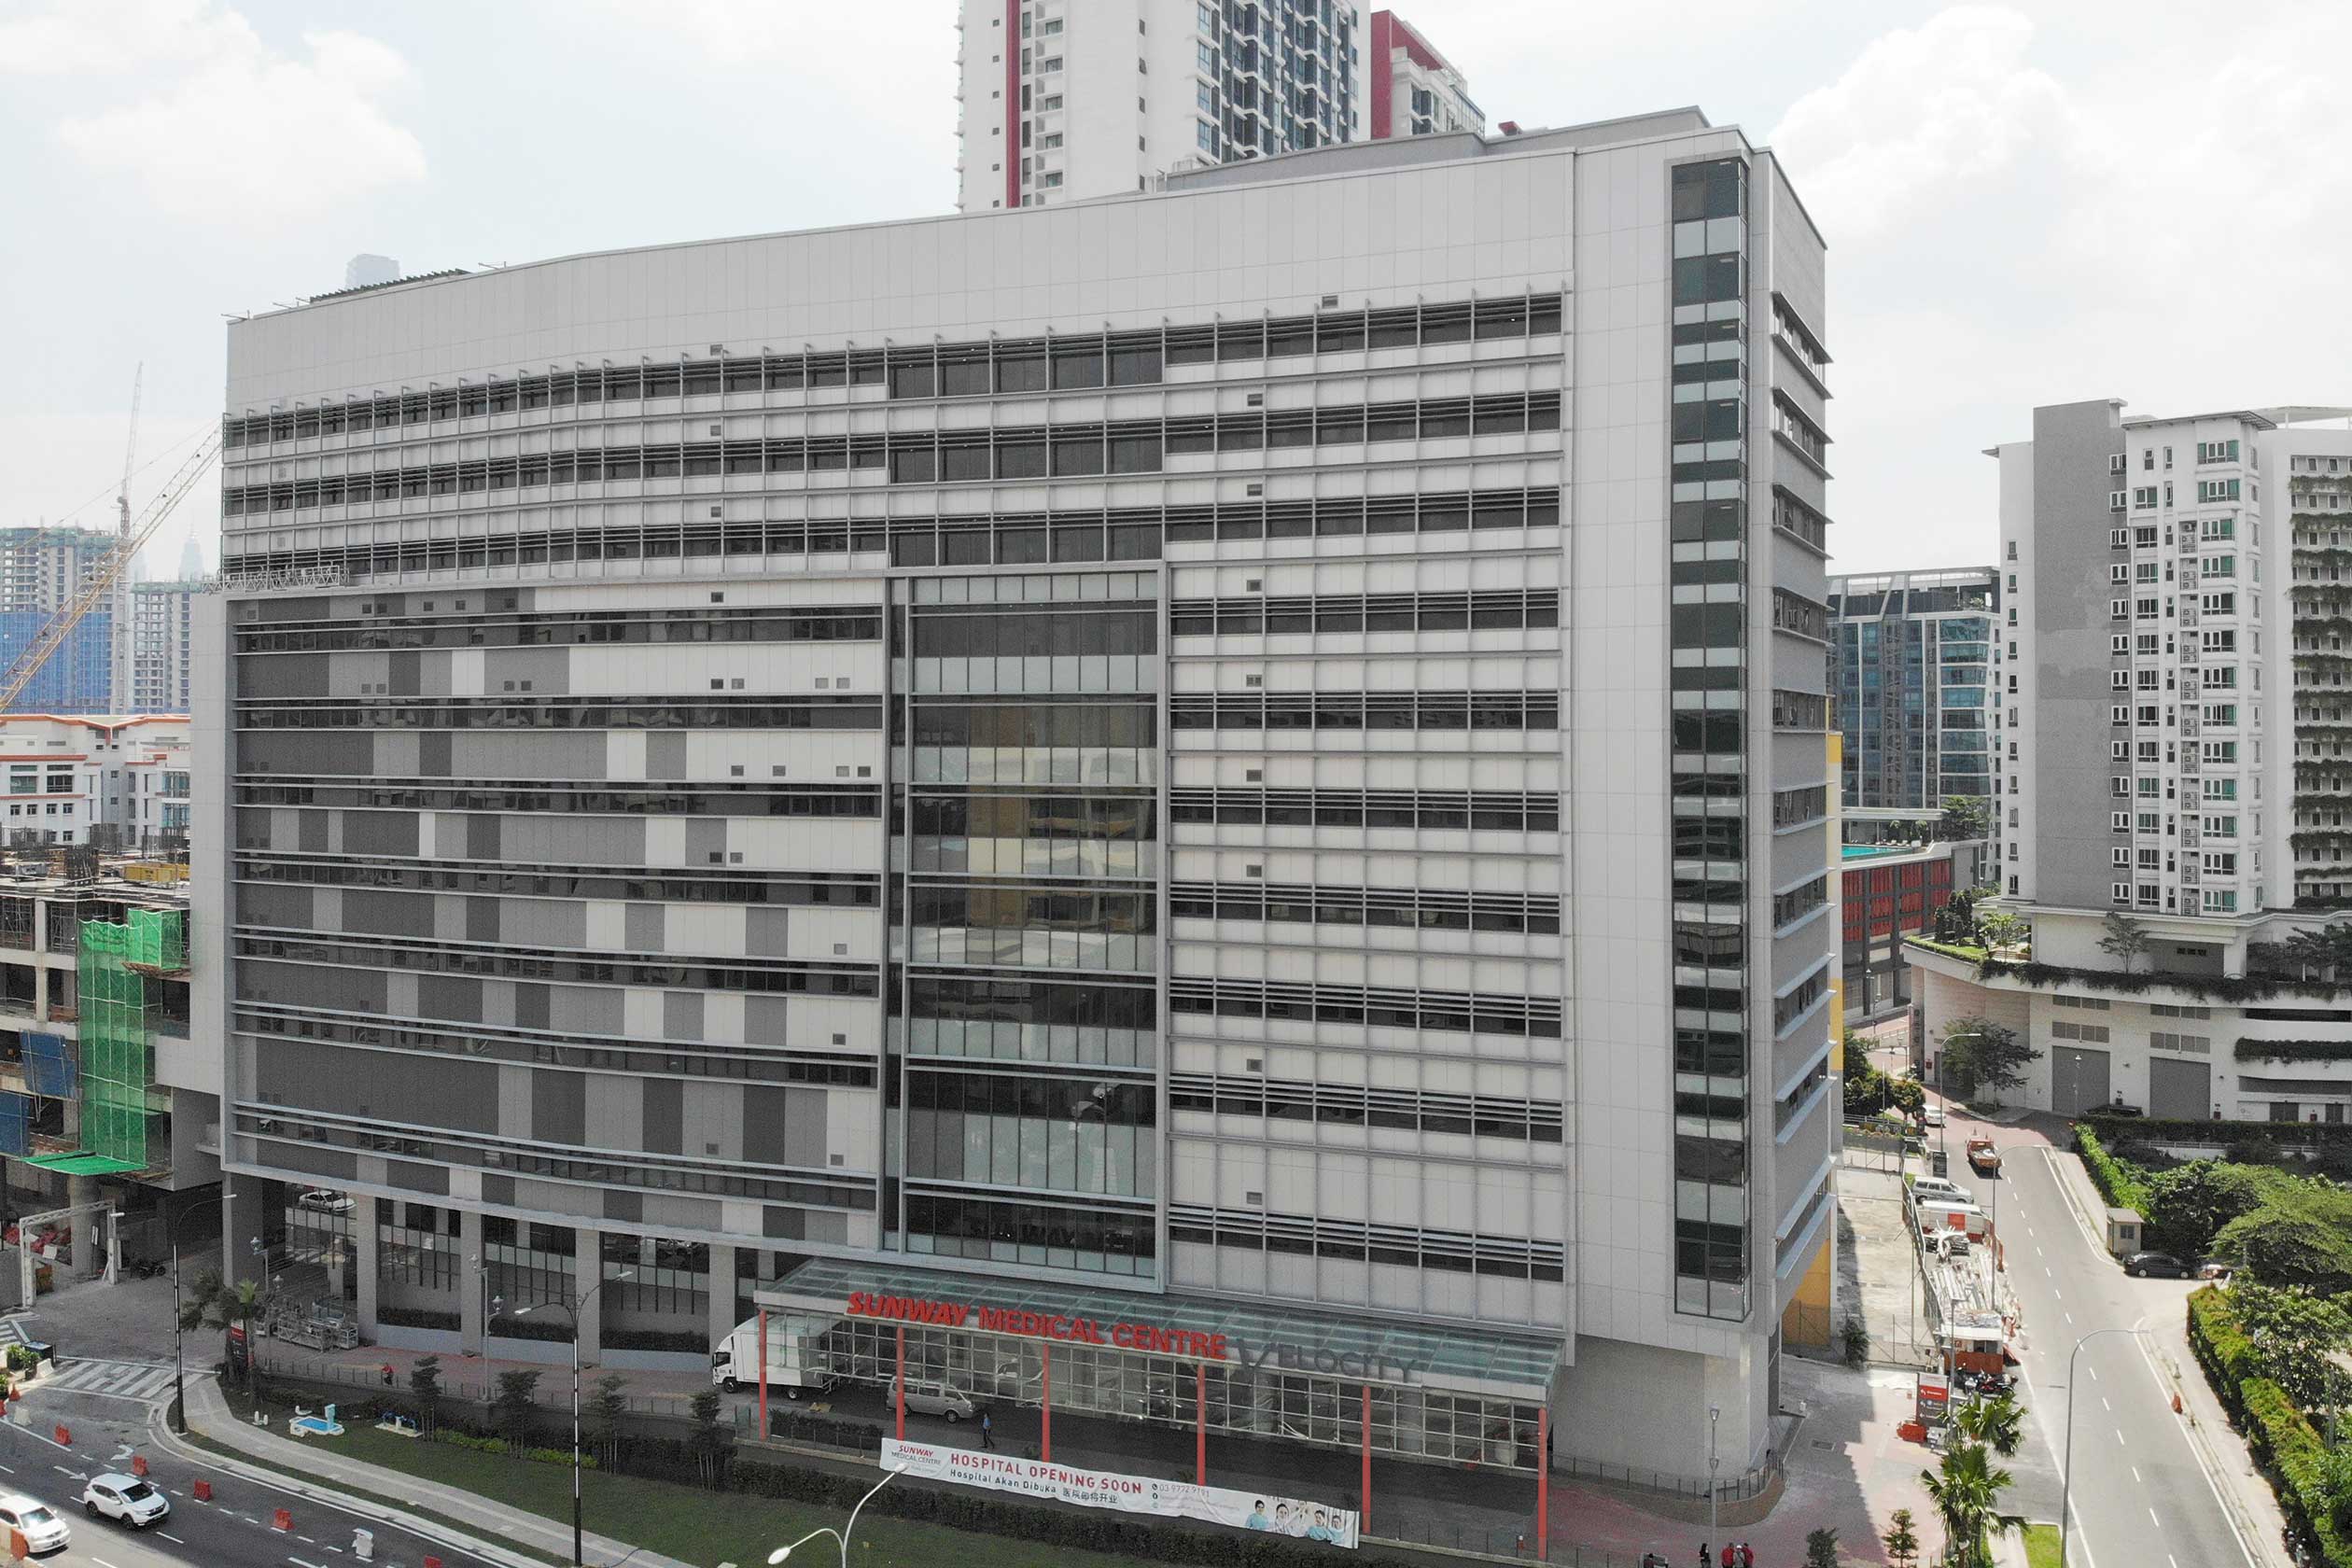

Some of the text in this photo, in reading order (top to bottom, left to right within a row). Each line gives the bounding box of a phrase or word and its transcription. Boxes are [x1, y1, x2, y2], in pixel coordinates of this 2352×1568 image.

[847, 1292, 1416, 1383] SUNWAY MEDICAL CENTRE VELOCITY
[891, 1451, 941, 1465] MEDICAL CENTRE
[899, 1445, 933, 1457] SUNWAY
[950, 1469, 991, 1482] Hospital
[995, 1477, 1019, 1487] Akan
[951, 1453, 1022, 1476] HOSPITAL
[1029, 1466, 1095, 1488] OPENING
[1101, 1478, 1141, 1494] SOON
[1159, 1484, 1169, 1492] 03
